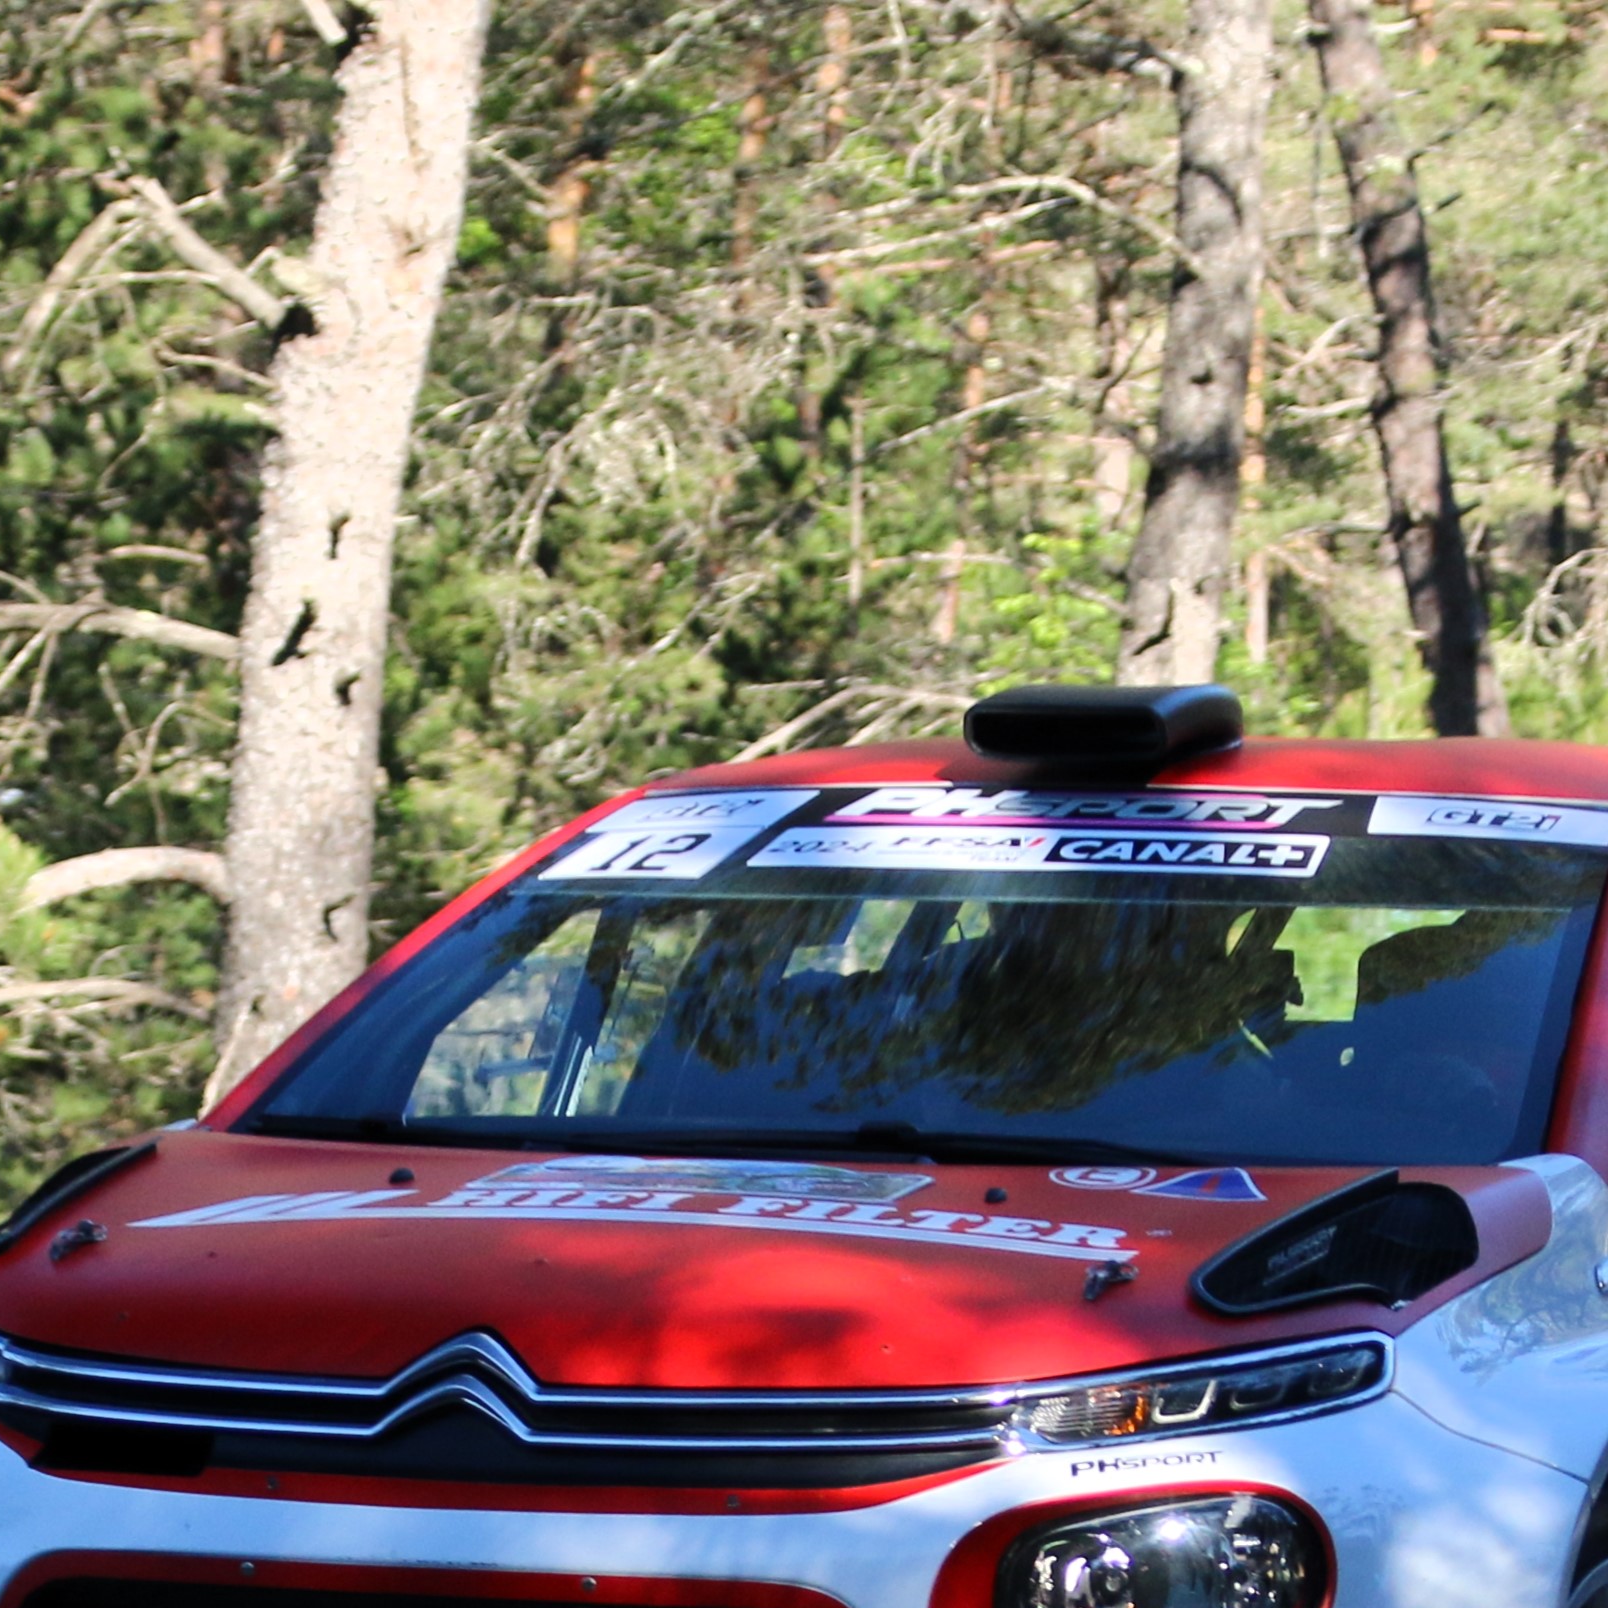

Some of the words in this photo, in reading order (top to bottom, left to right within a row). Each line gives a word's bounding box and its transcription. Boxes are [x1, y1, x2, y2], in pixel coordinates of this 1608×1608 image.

[833, 787, 1344, 825] PHSPORT
[588, 833, 712, 872] 12
[768, 840, 872, 854] 2024
[1059, 840, 1305, 867] CANAL+
[717, 1196, 1132, 1250] FILTER
[1070, 1451, 1223, 1477] PHSPORT
